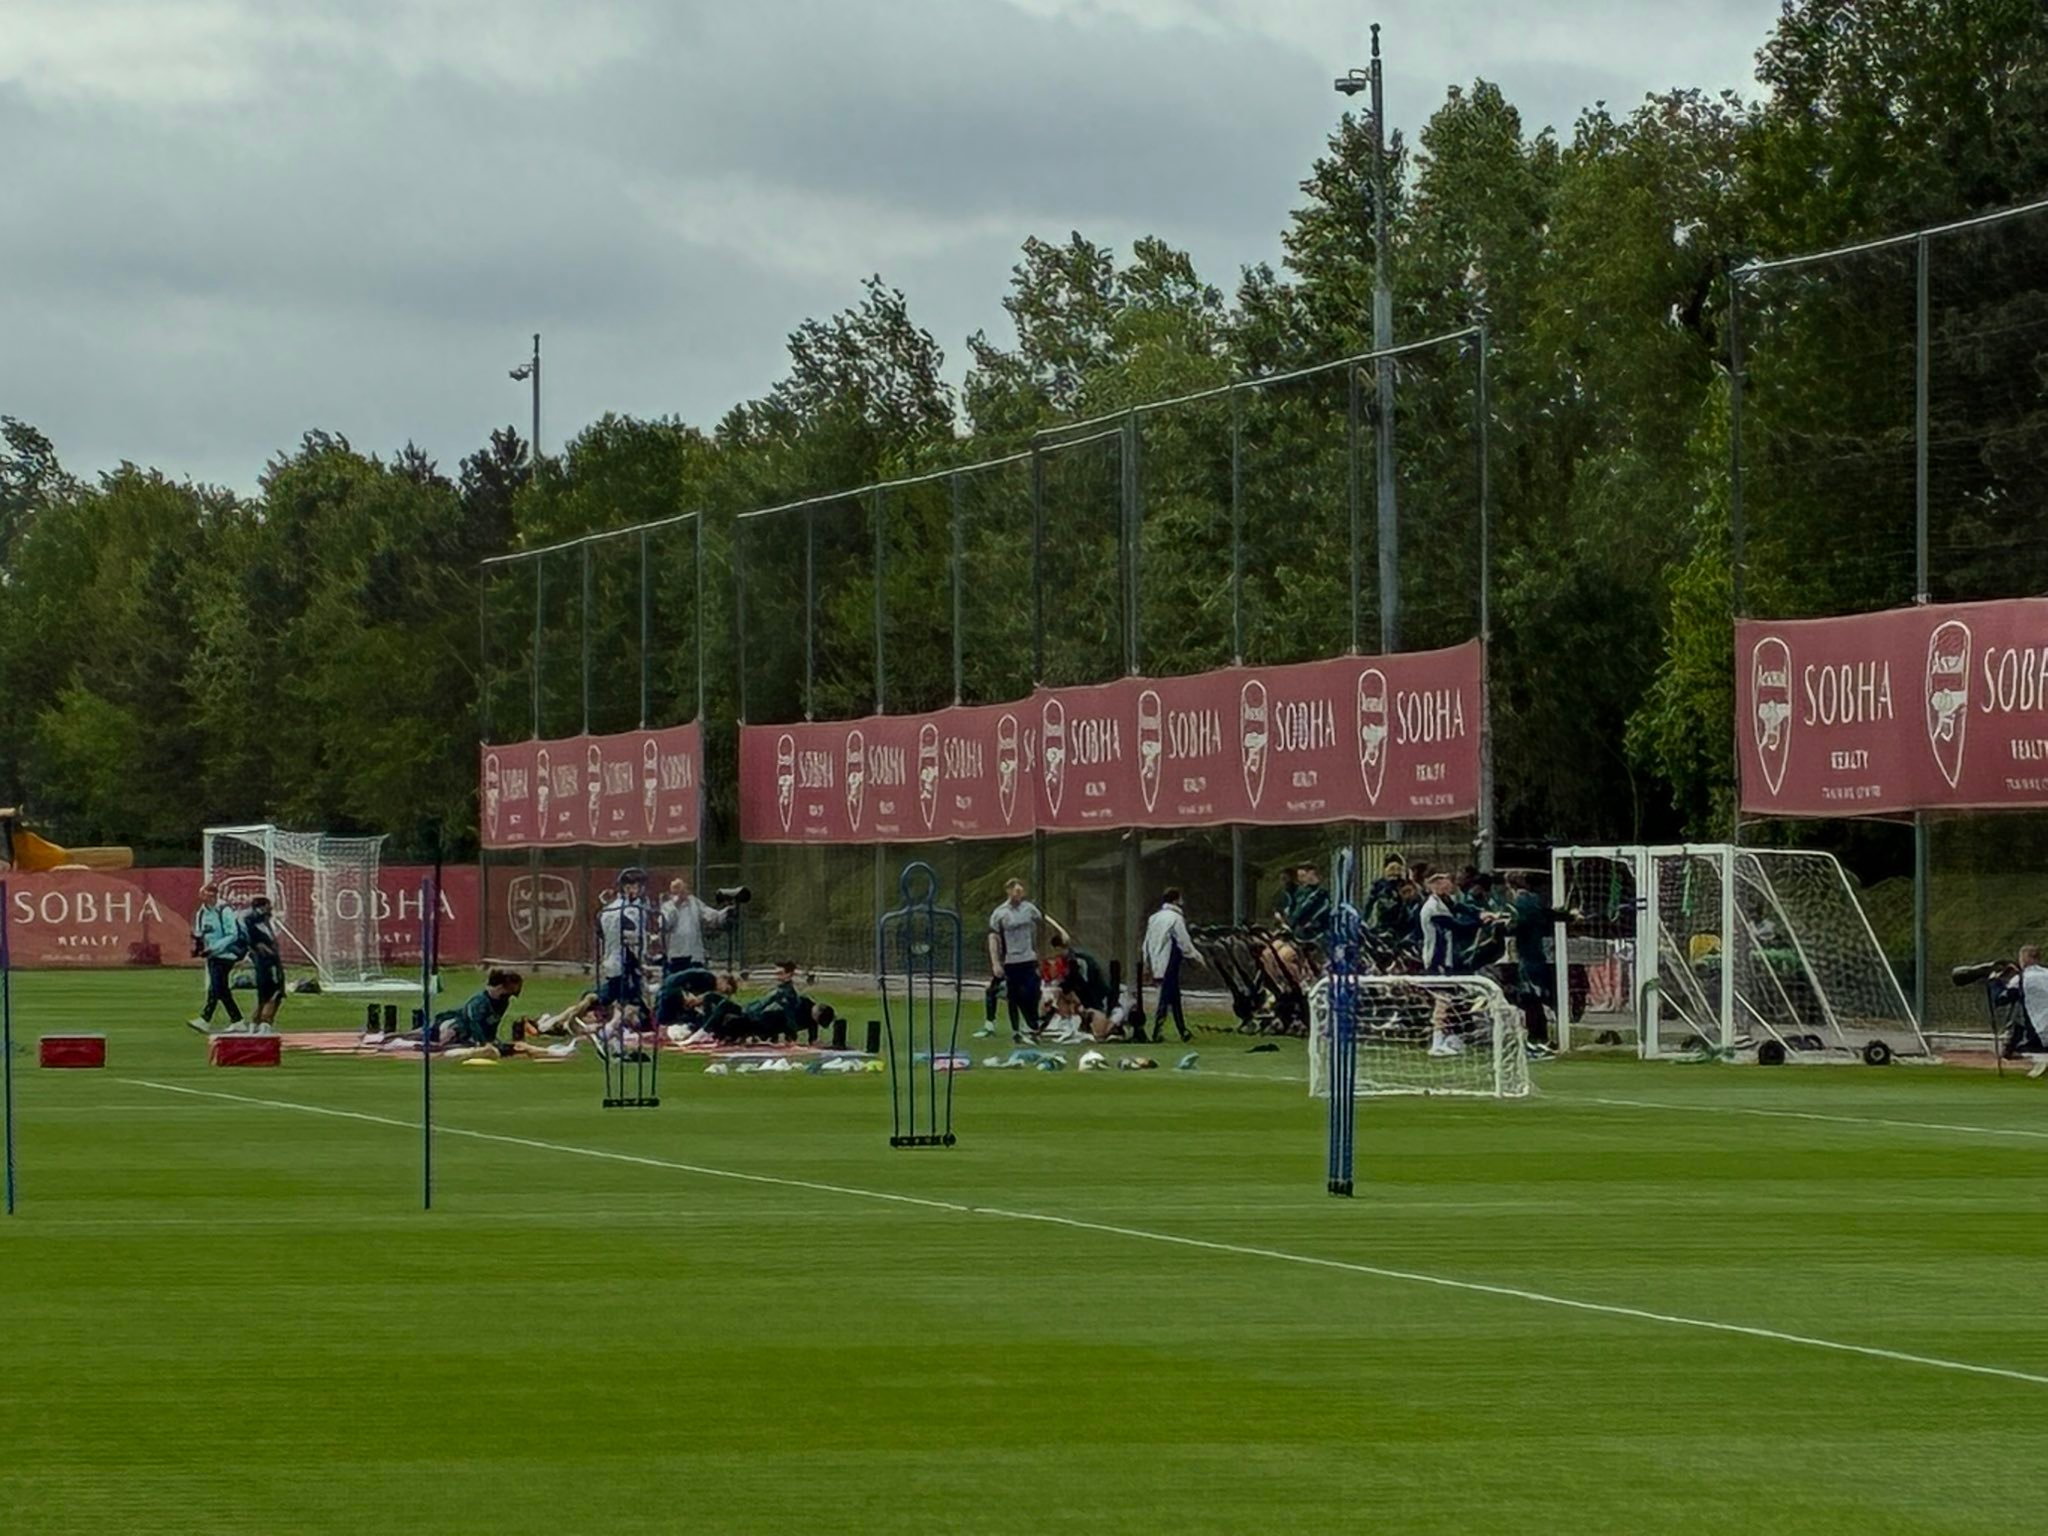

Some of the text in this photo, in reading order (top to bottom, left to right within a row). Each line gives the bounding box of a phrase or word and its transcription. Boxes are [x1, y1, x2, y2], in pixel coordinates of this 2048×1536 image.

[1396, 688, 1465, 745] SOBHA
[1804, 661, 1894, 726] SOBHA
[1071, 718, 1122, 766] SOBHA
[1168, 709, 1222, 760] SOBHA
[1275, 699, 1336, 751] SOBHA
[14, 891, 163, 924] SOBHA
